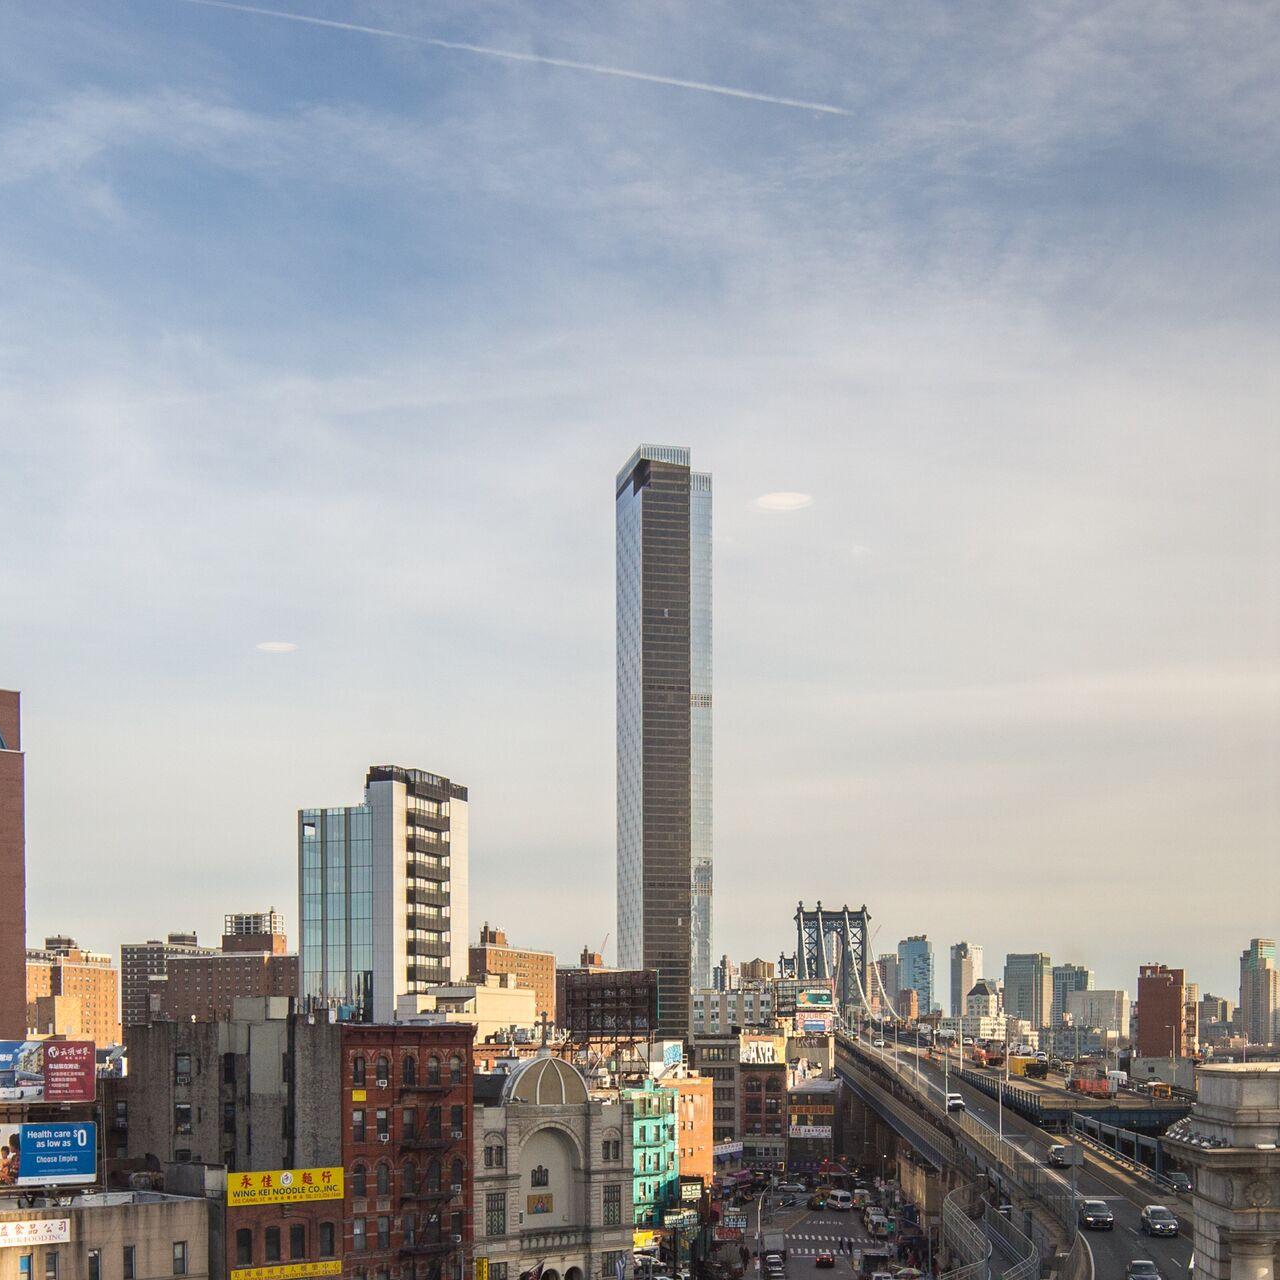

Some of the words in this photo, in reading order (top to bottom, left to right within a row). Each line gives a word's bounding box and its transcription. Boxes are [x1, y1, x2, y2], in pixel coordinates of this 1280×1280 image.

[27, 1130, 52, 1139] Health
[53, 1130, 71, 1138] care
[47, 1139, 60, 1148] low
[36, 1155, 58, 1164] Choose
[58, 1155, 78, 1164] Empire
[232, 1189, 256, 1198] WING
[258, 1189, 271, 1197] KEI
[272, 1186, 306, 1195] NOODLE
[23, 1235, 48, 1243] FOOD
